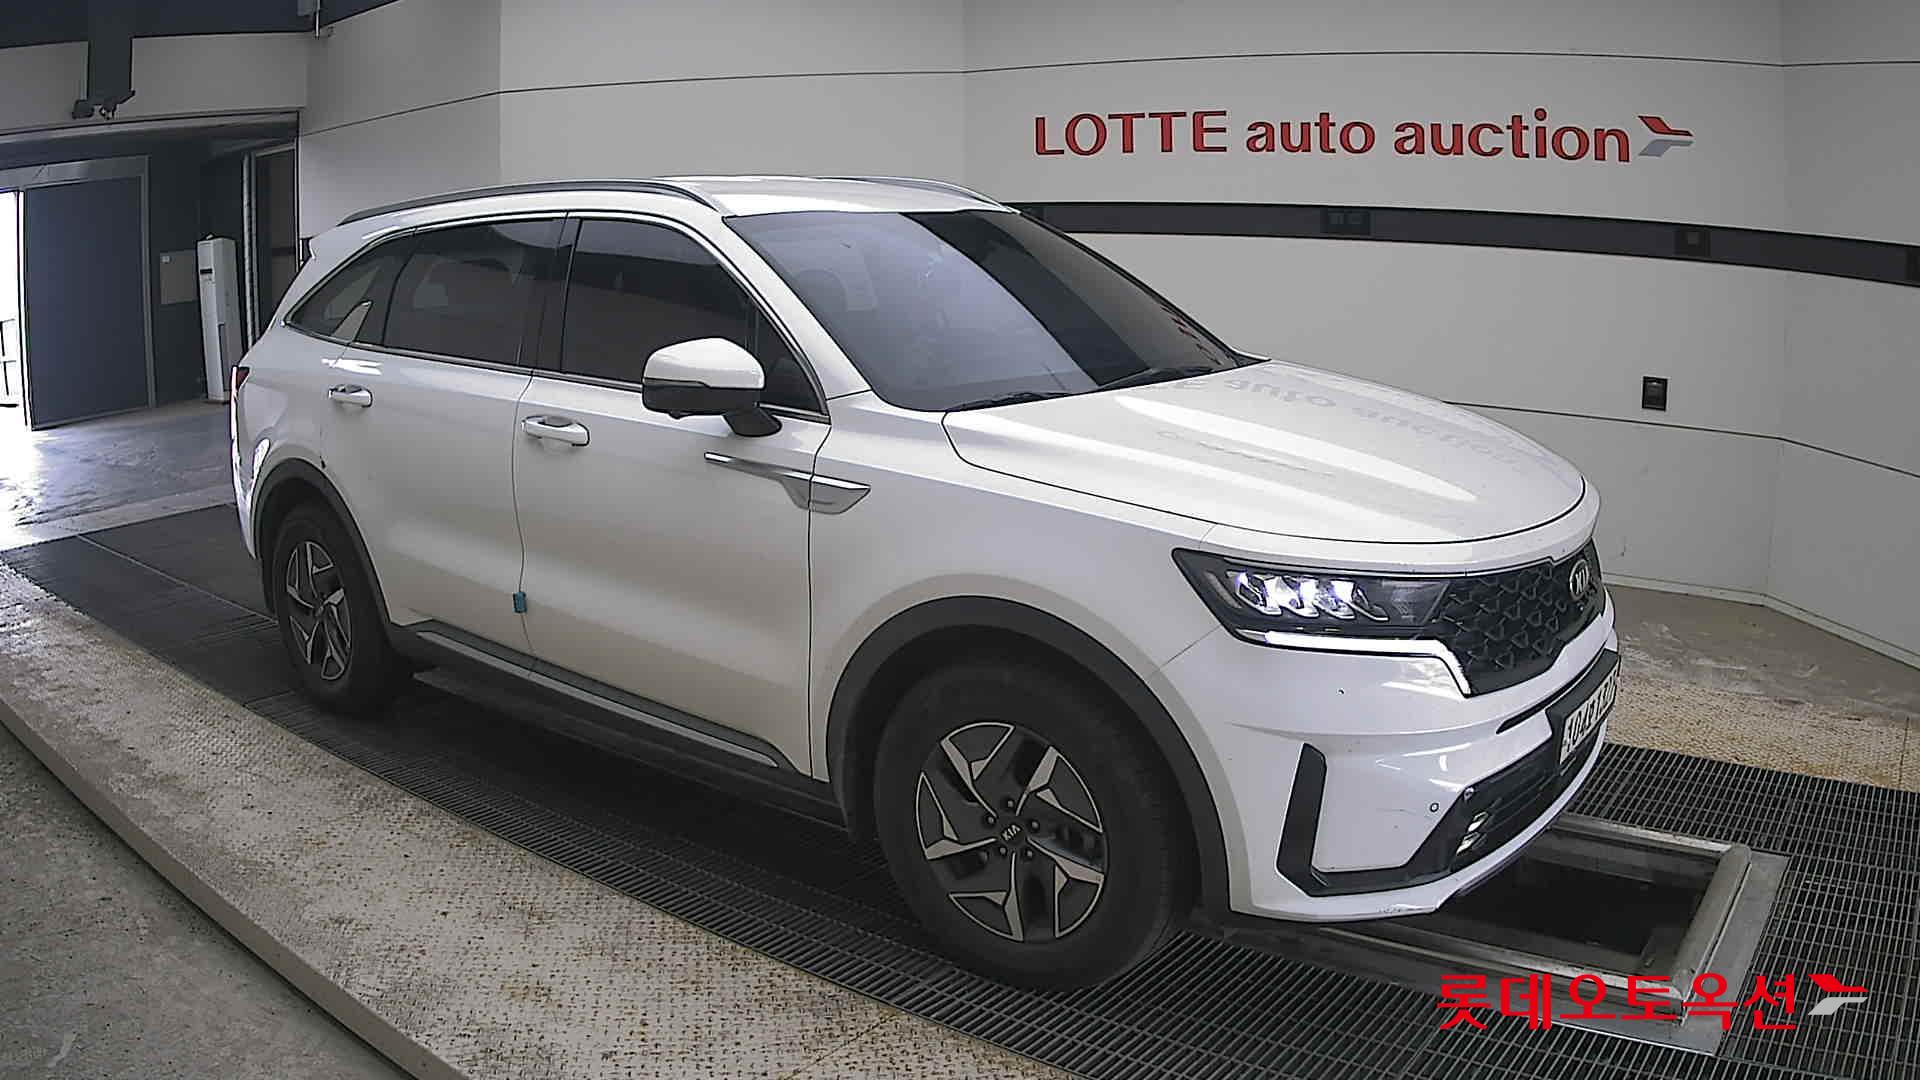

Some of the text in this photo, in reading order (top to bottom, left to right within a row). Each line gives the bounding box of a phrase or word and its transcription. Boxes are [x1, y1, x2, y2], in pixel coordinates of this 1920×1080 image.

[1035, 108, 1631, 163] LOTTE auto auction
[1001, 824, 1021, 841] KIA
